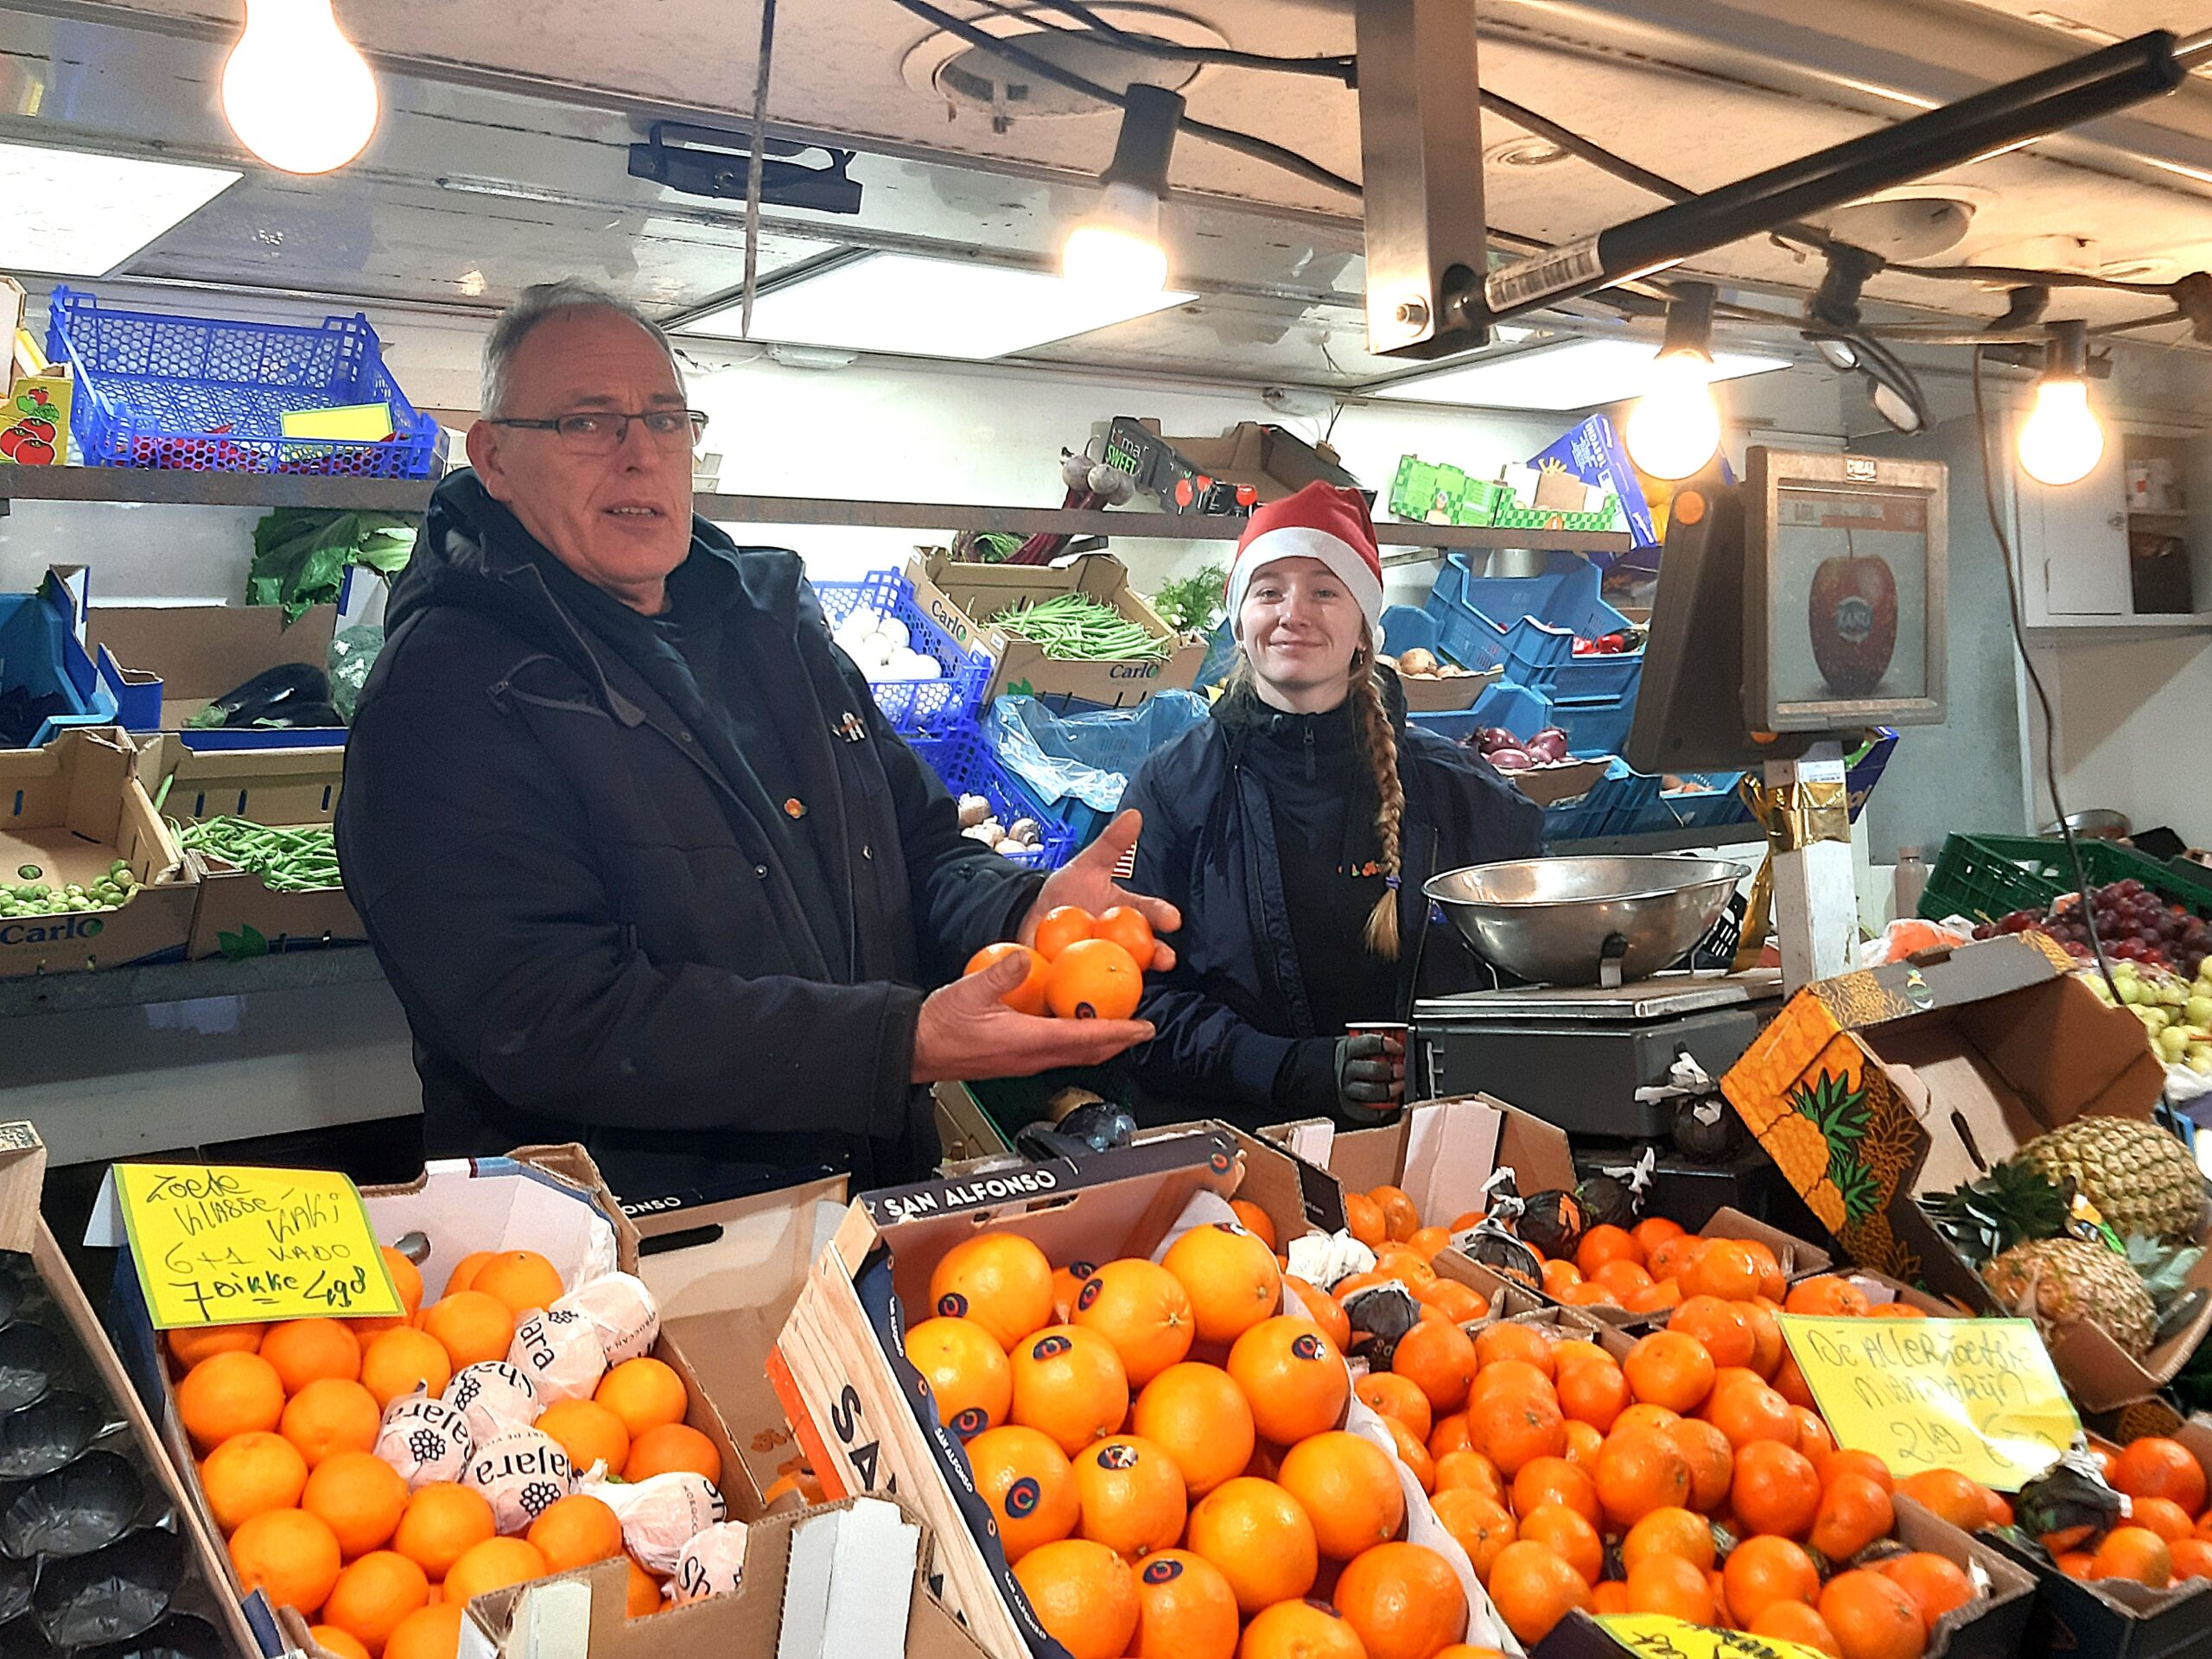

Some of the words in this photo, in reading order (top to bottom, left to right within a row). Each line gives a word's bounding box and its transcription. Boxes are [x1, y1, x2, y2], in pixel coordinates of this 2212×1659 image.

[1107, 443, 1137, 475] SWEET
[1585, 422, 1607, 468] INDASOL
[931, 600, 968, 642] Carlo
[1109, 662, 1159, 679] Carlo
[0, 917, 104, 944] Carlo
[620, 1196, 682, 1216] ONSO
[883, 1191, 938, 1217] SAN
[944, 1169, 1058, 1208] ALFONSO
[831, 1383, 897, 1494] SA
[934, 1427, 949, 1451] SAN
[944, 1447, 975, 1493] ALFONSO
[1014, 1595, 1047, 1641] ALFONSO
